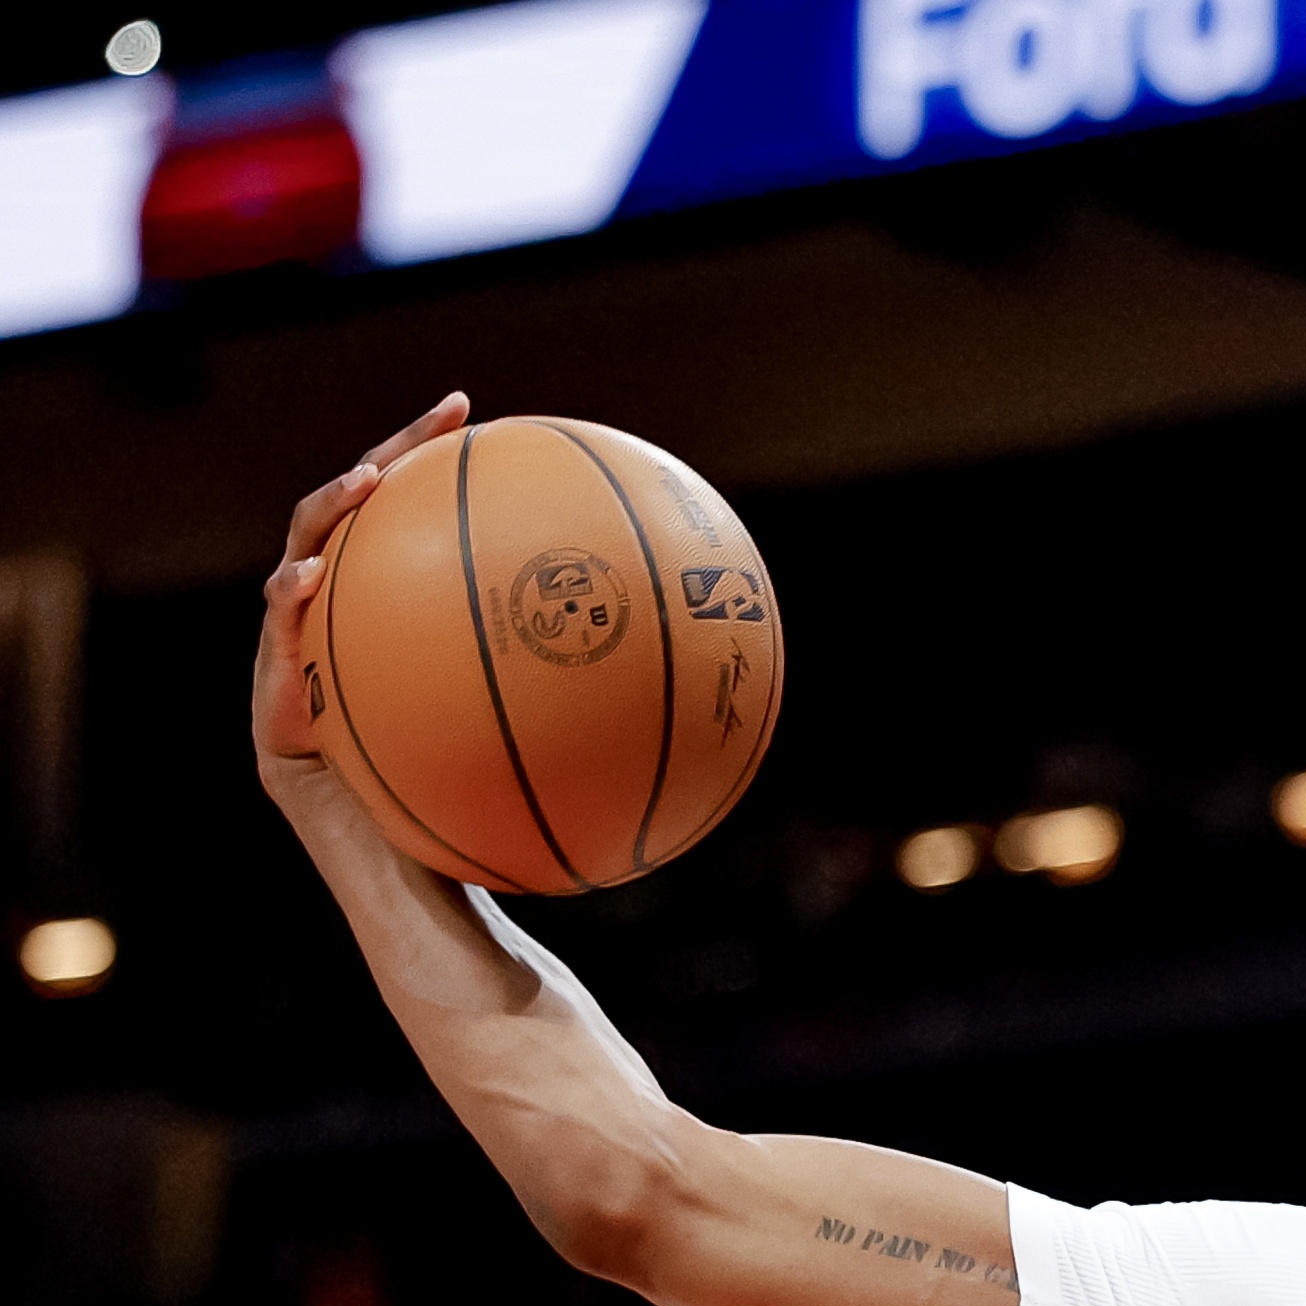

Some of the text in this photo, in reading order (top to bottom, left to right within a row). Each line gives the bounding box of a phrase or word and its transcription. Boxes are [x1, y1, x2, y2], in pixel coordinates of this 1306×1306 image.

[815, 1214, 856, 1245] NO
[860, 1228, 931, 1263] PAIN
[934, 1247, 977, 1274] NO
